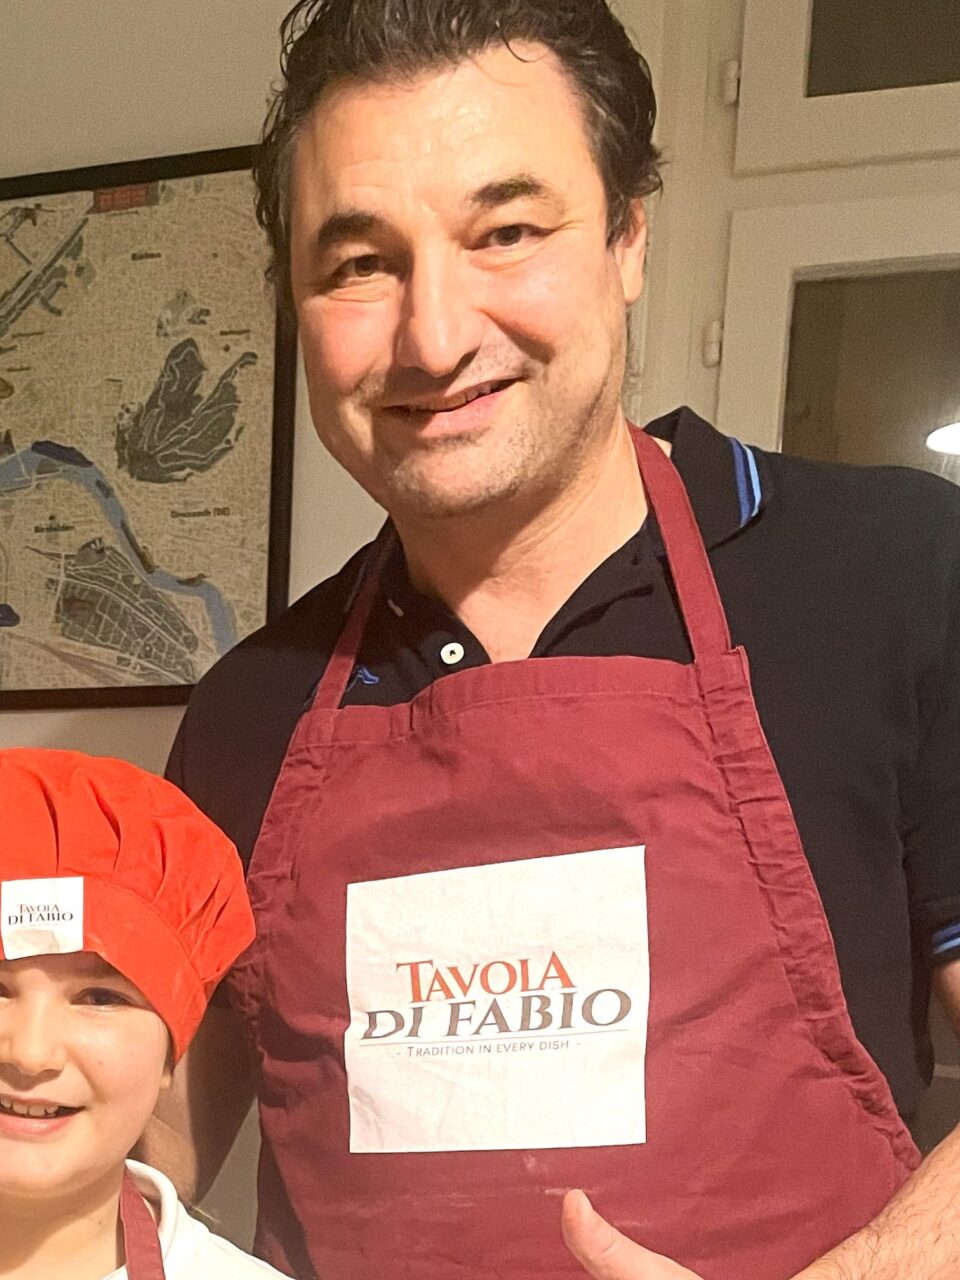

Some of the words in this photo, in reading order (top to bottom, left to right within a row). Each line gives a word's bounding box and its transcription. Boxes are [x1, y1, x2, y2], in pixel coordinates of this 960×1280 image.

[8, 913, 23, 925] DI
[396, 951, 576, 1003] TAVOLA
[360, 1006, 426, 1041] DI
[443, 988, 632, 1037] FABIO
[407, 1044, 474, 1058] TRADITION
[478, 1044, 491, 1054] IN
[496, 1042, 534, 1053] EVERY
[539, 1040, 569, 1051] DISH
